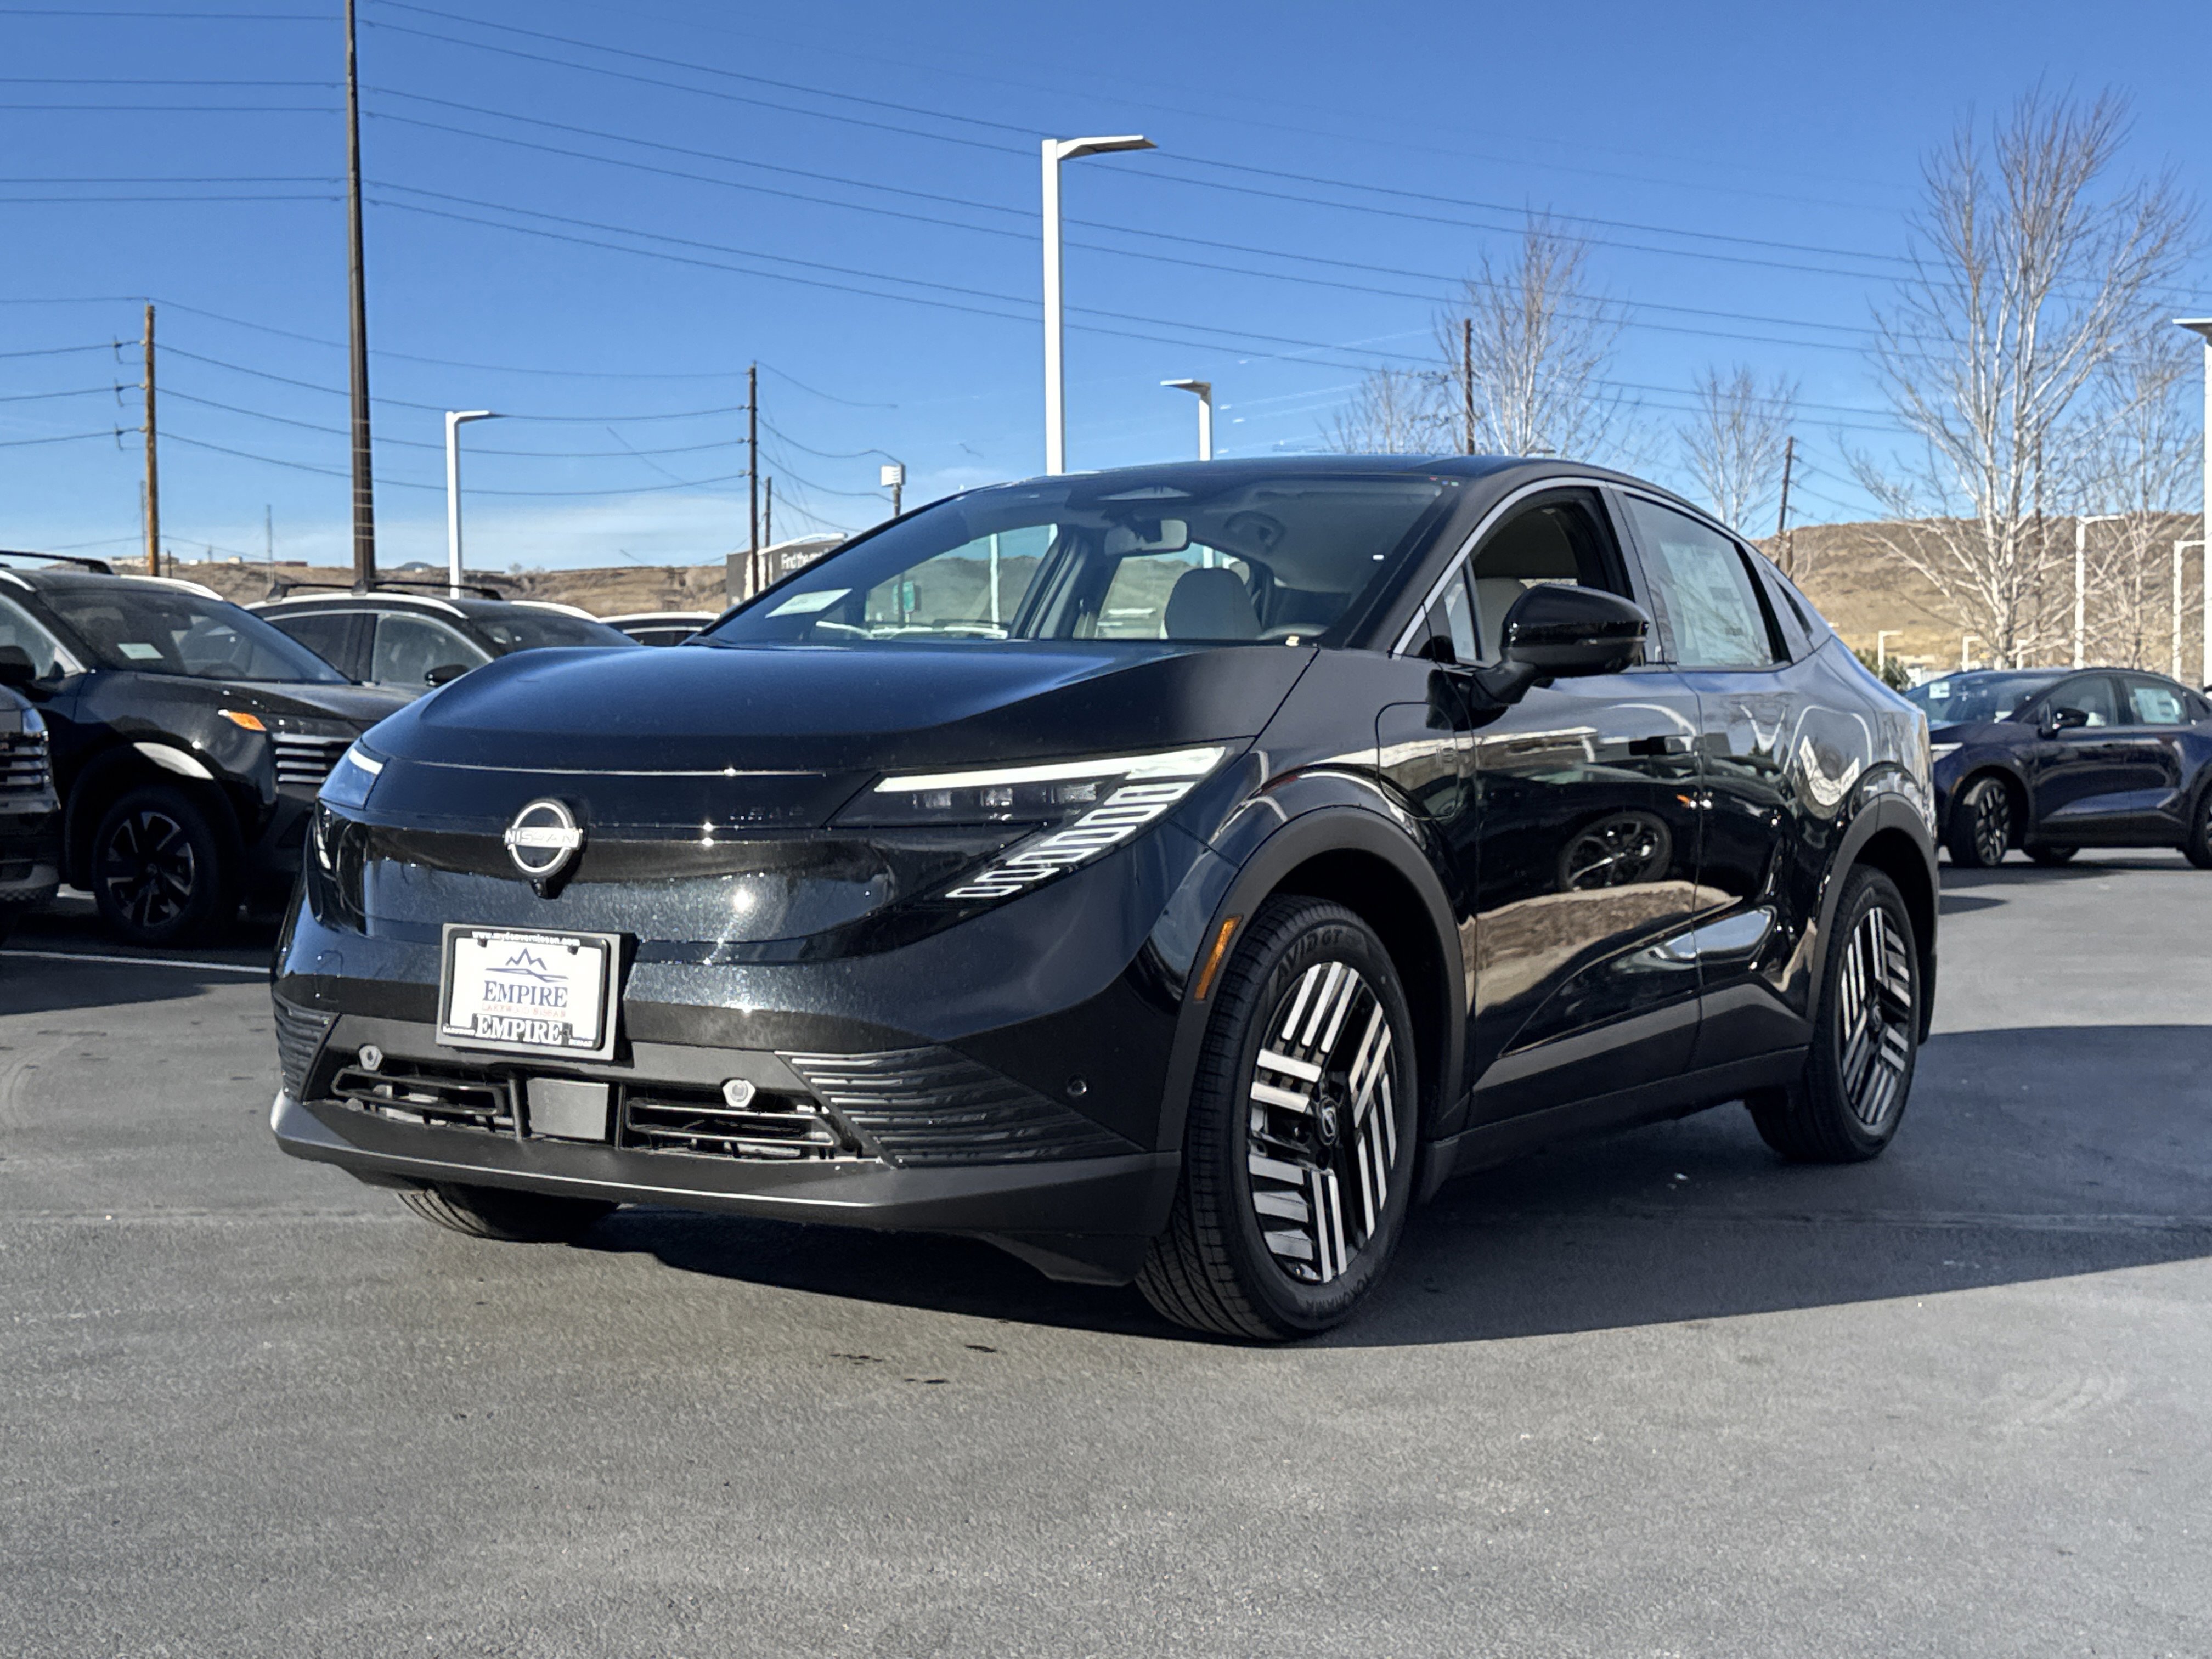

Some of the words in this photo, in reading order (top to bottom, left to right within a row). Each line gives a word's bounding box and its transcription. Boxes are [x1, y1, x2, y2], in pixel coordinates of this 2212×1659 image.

[504, 830, 574, 844] NISSAN
[482, 980, 568, 1008] EMPIRE
[475, 1013, 563, 1045] EMPIRE
